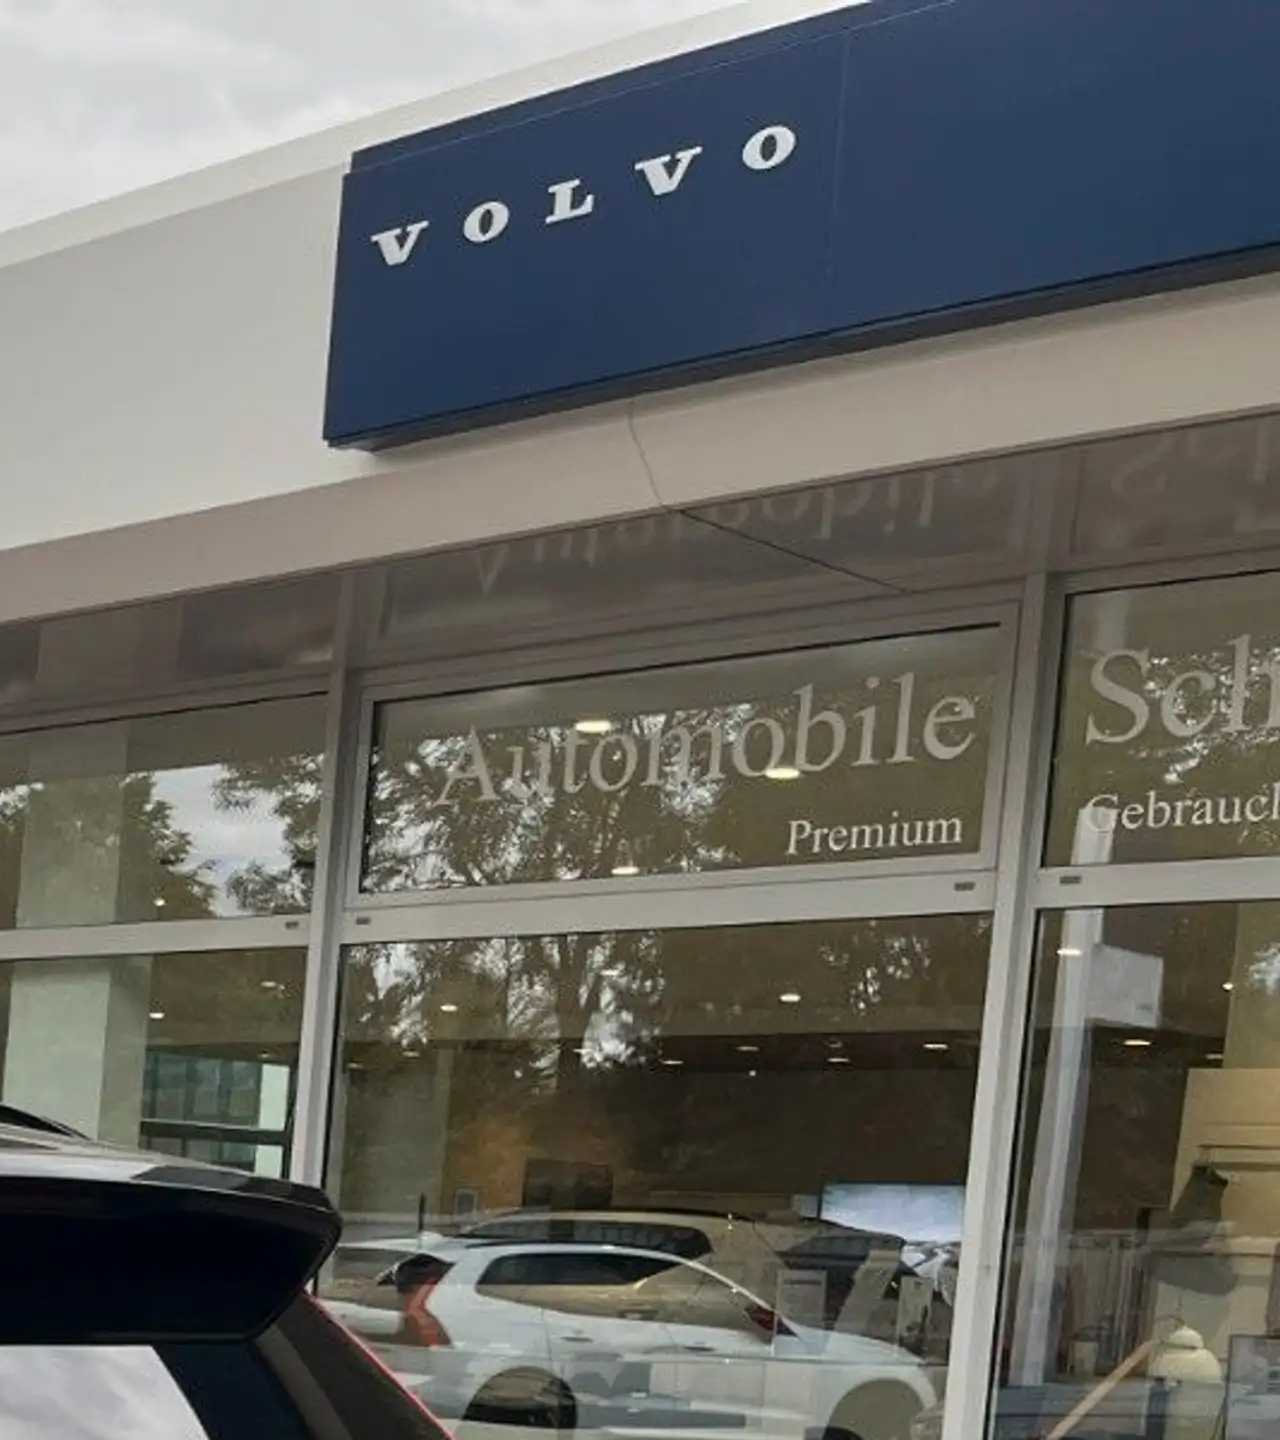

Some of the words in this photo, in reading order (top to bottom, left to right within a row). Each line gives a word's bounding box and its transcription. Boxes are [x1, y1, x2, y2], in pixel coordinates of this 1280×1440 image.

[370, 125, 797, 267] VOLVO
[435, 673, 977, 806] Automobile
[787, 811, 963, 856] Premium
